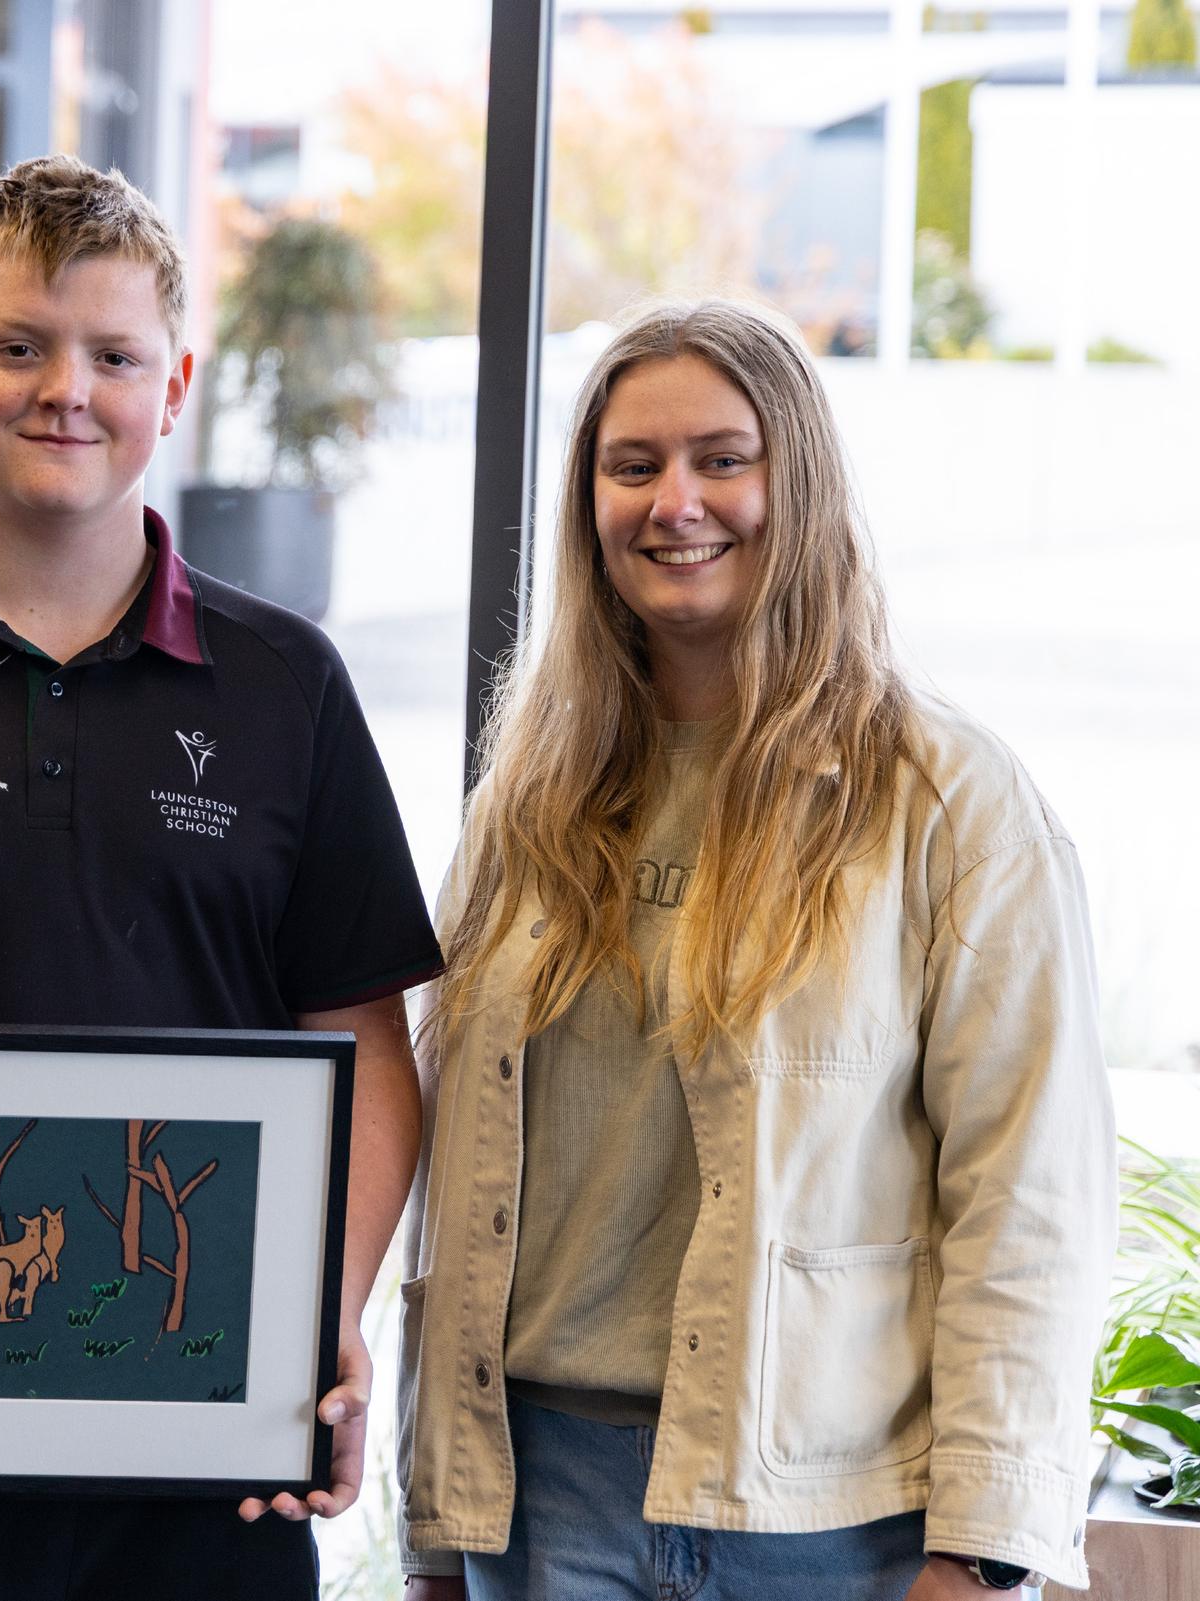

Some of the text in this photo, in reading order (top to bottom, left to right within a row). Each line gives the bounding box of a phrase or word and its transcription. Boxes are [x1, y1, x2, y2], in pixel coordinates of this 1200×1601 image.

[151, 789, 238, 816] LAUNCESTON
[160, 804, 230, 827] CHRISTIAN
[166, 818, 225, 838] SCHOOL
